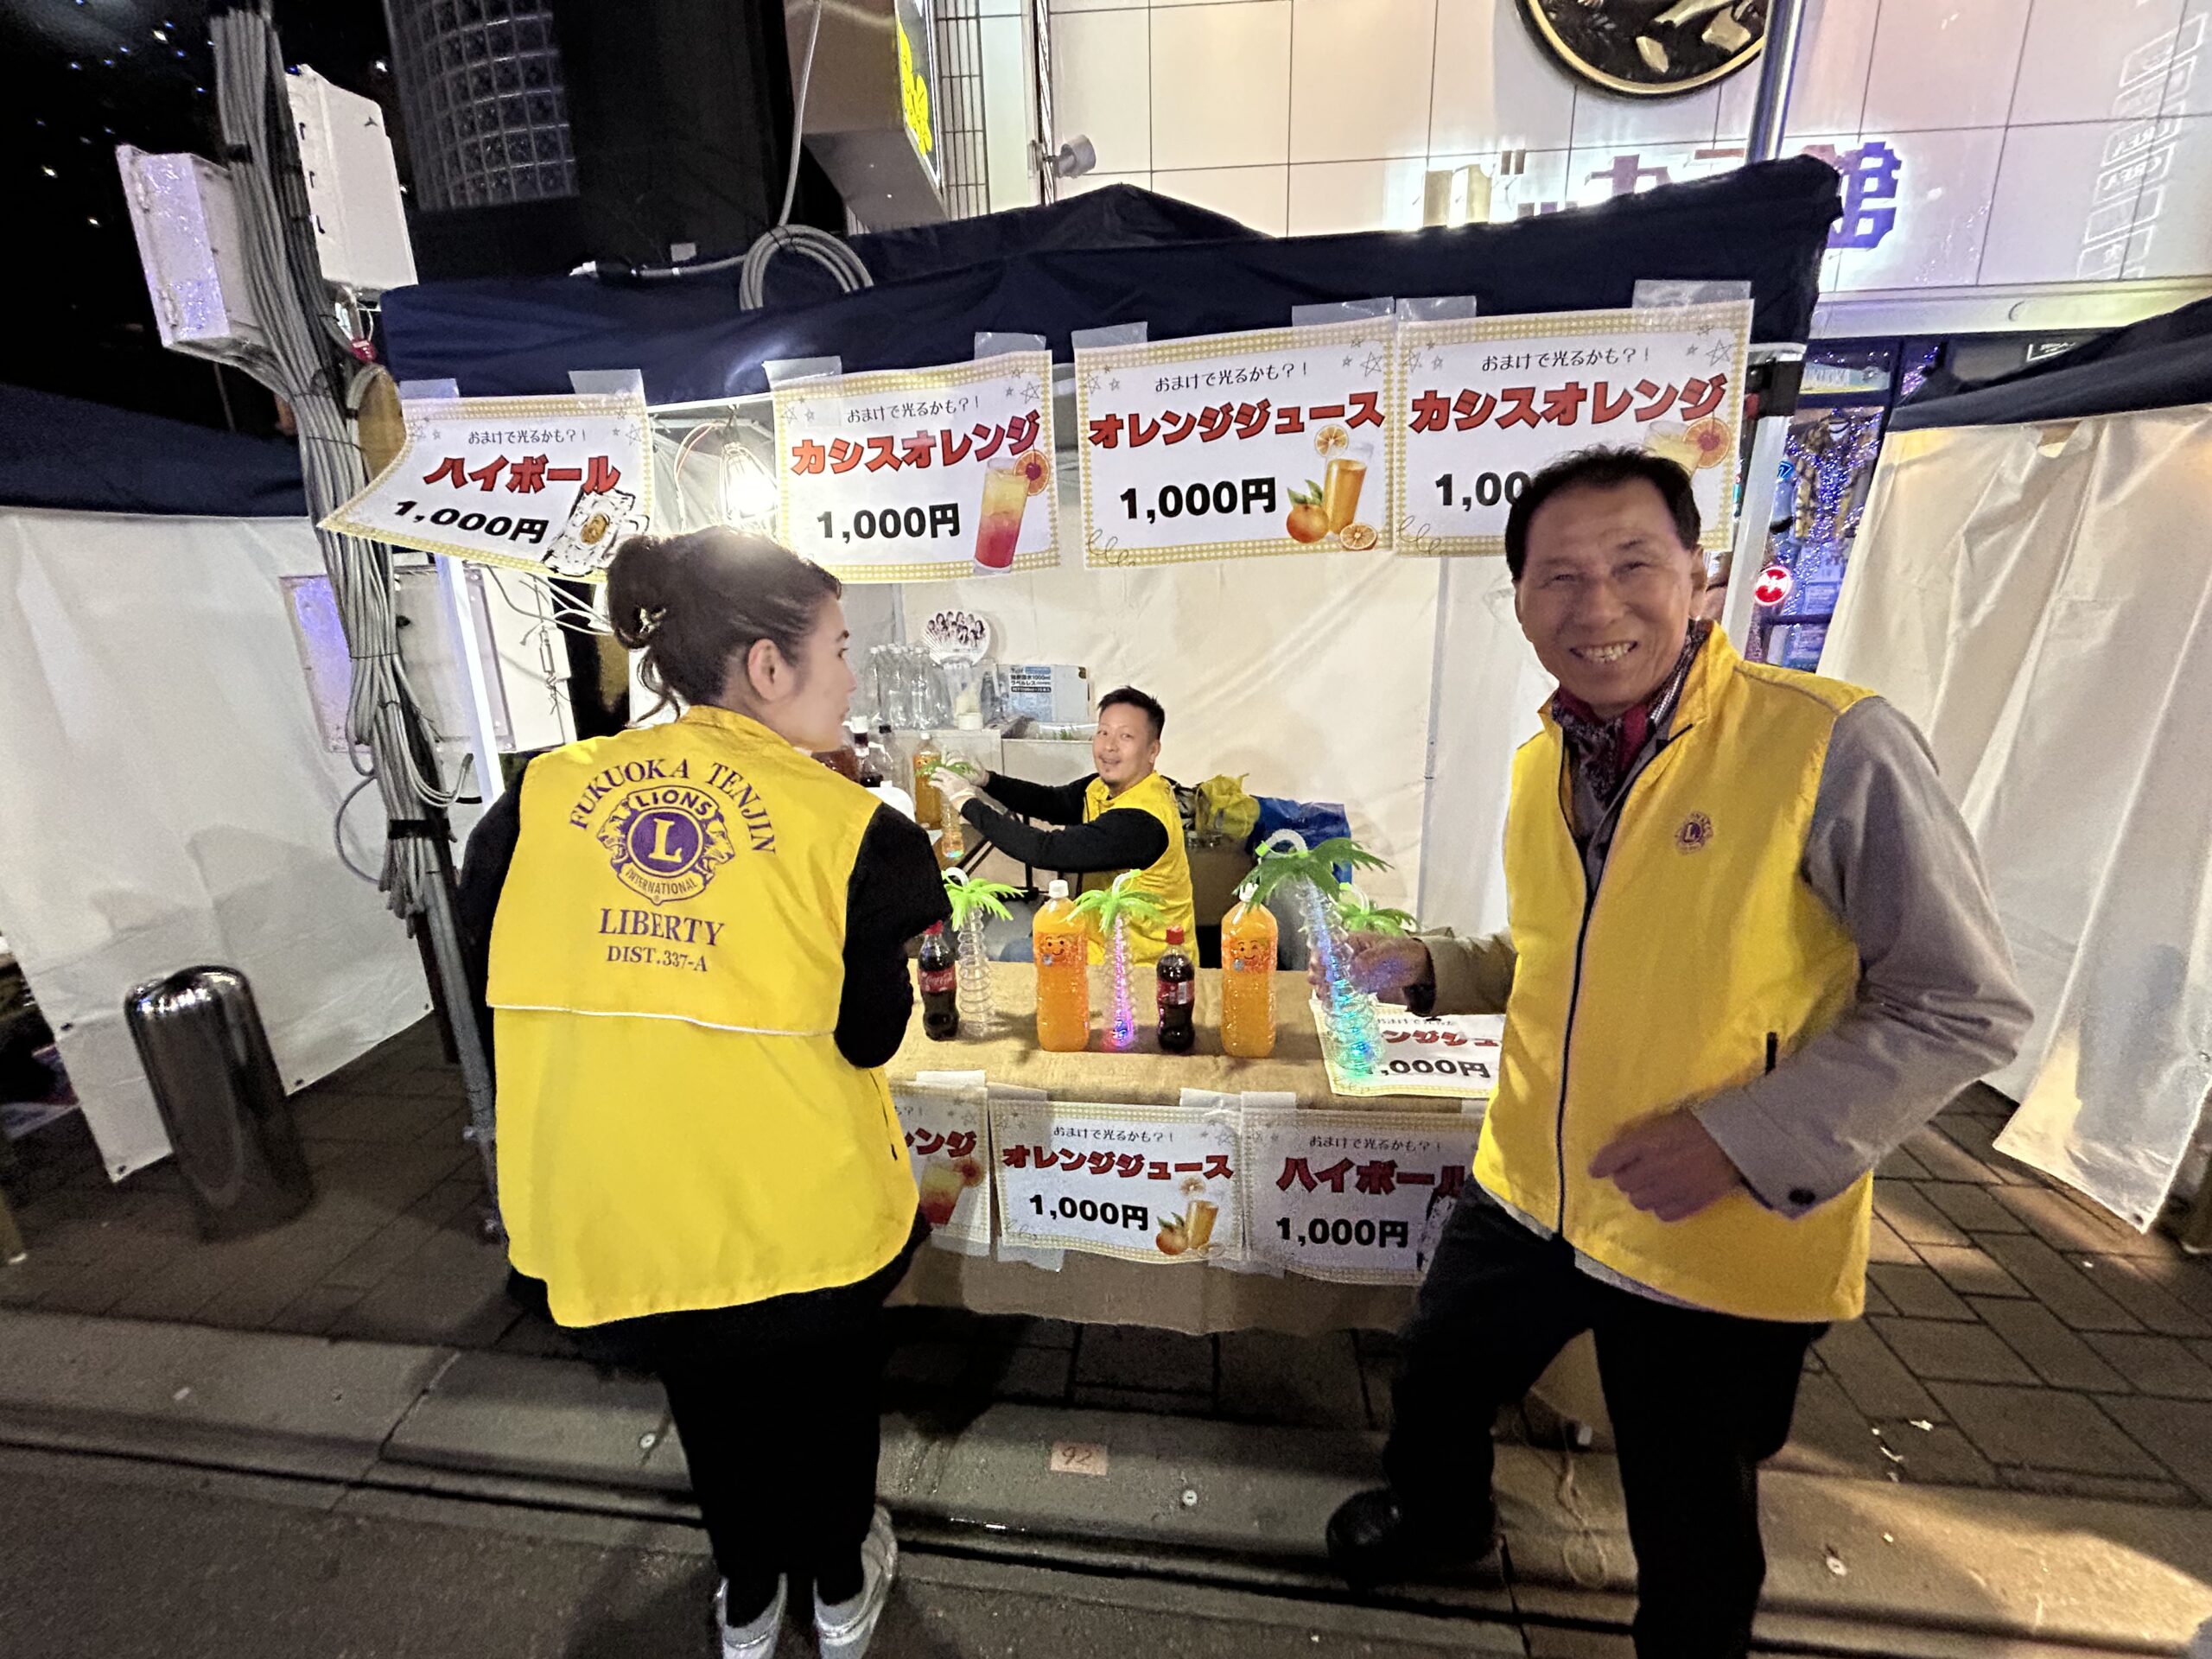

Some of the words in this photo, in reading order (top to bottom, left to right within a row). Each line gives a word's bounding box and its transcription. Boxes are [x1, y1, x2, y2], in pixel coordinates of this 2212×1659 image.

[1088, 391, 1386, 448] オレンジジュース
[1408, 373, 1728, 434] カシスオレンジ
[791, 410, 1041, 475] カシスオレンジ
[423, 454, 621, 494] ハイボール
[1435, 471, 1531, 512] 1,00
[1120, 477, 1277, 524] 1,000円
[393, 500, 550, 544] 1,000円
[817, 503, 961, 544] 1,000円
[569, 758, 690, 830] FUKUOKA
[705, 761, 776, 855] TENJIN
[635, 789, 713, 817] LIONS
[648, 817, 683, 864] L
[625, 868, 697, 895] INTERNATIONAL
[598, 907, 725, 946] LIBERTY
[607, 945, 708, 972] DIST.337-A
[1382, 1029, 1500, 1046] ンジジュ
[1379, 1059, 1491, 1078] ,000円
[1002, 1145, 1234, 1180] オレンジジュース
[1275, 1157, 1465, 1197] ハイボール
[1029, 1194, 1149, 1231] 1,000円
[1276, 1217, 1408, 1249] 1,000円
